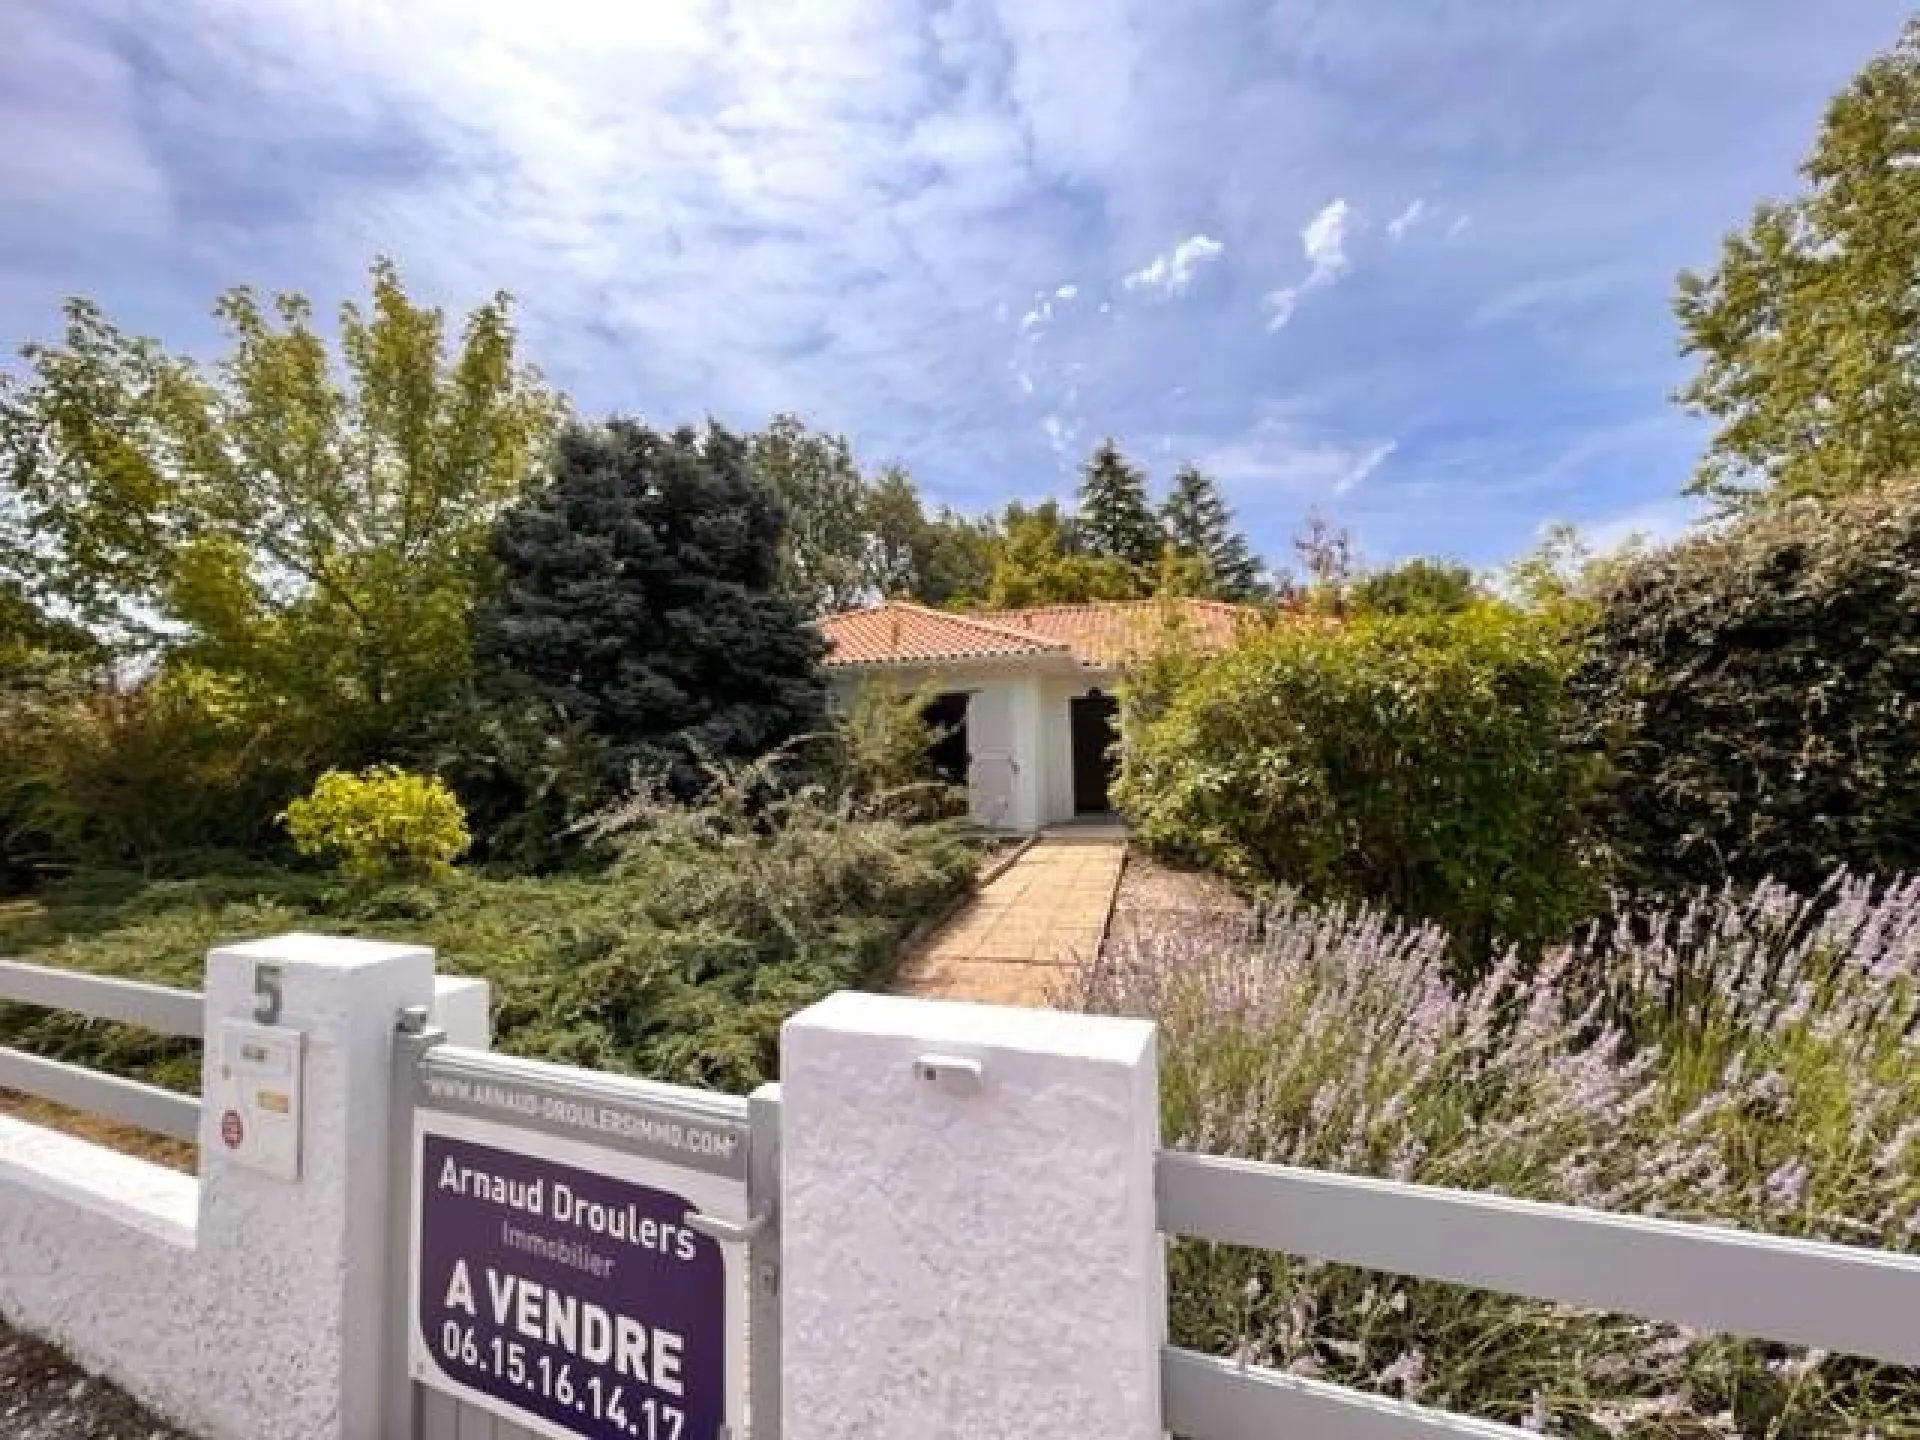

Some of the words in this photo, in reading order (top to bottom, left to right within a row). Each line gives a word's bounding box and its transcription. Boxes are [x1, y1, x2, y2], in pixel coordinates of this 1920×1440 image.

[254, 965, 281, 1025] 5
[438, 1155, 544, 1215] Arnaud
[551, 1183, 697, 1261] Droulers
[503, 1220, 616, 1278] Immobilier
[443, 1318, 685, 1440] 06.15.16.14.17
[444, 1258, 478, 1316] A
[485, 1267, 685, 1397] VENDRE
